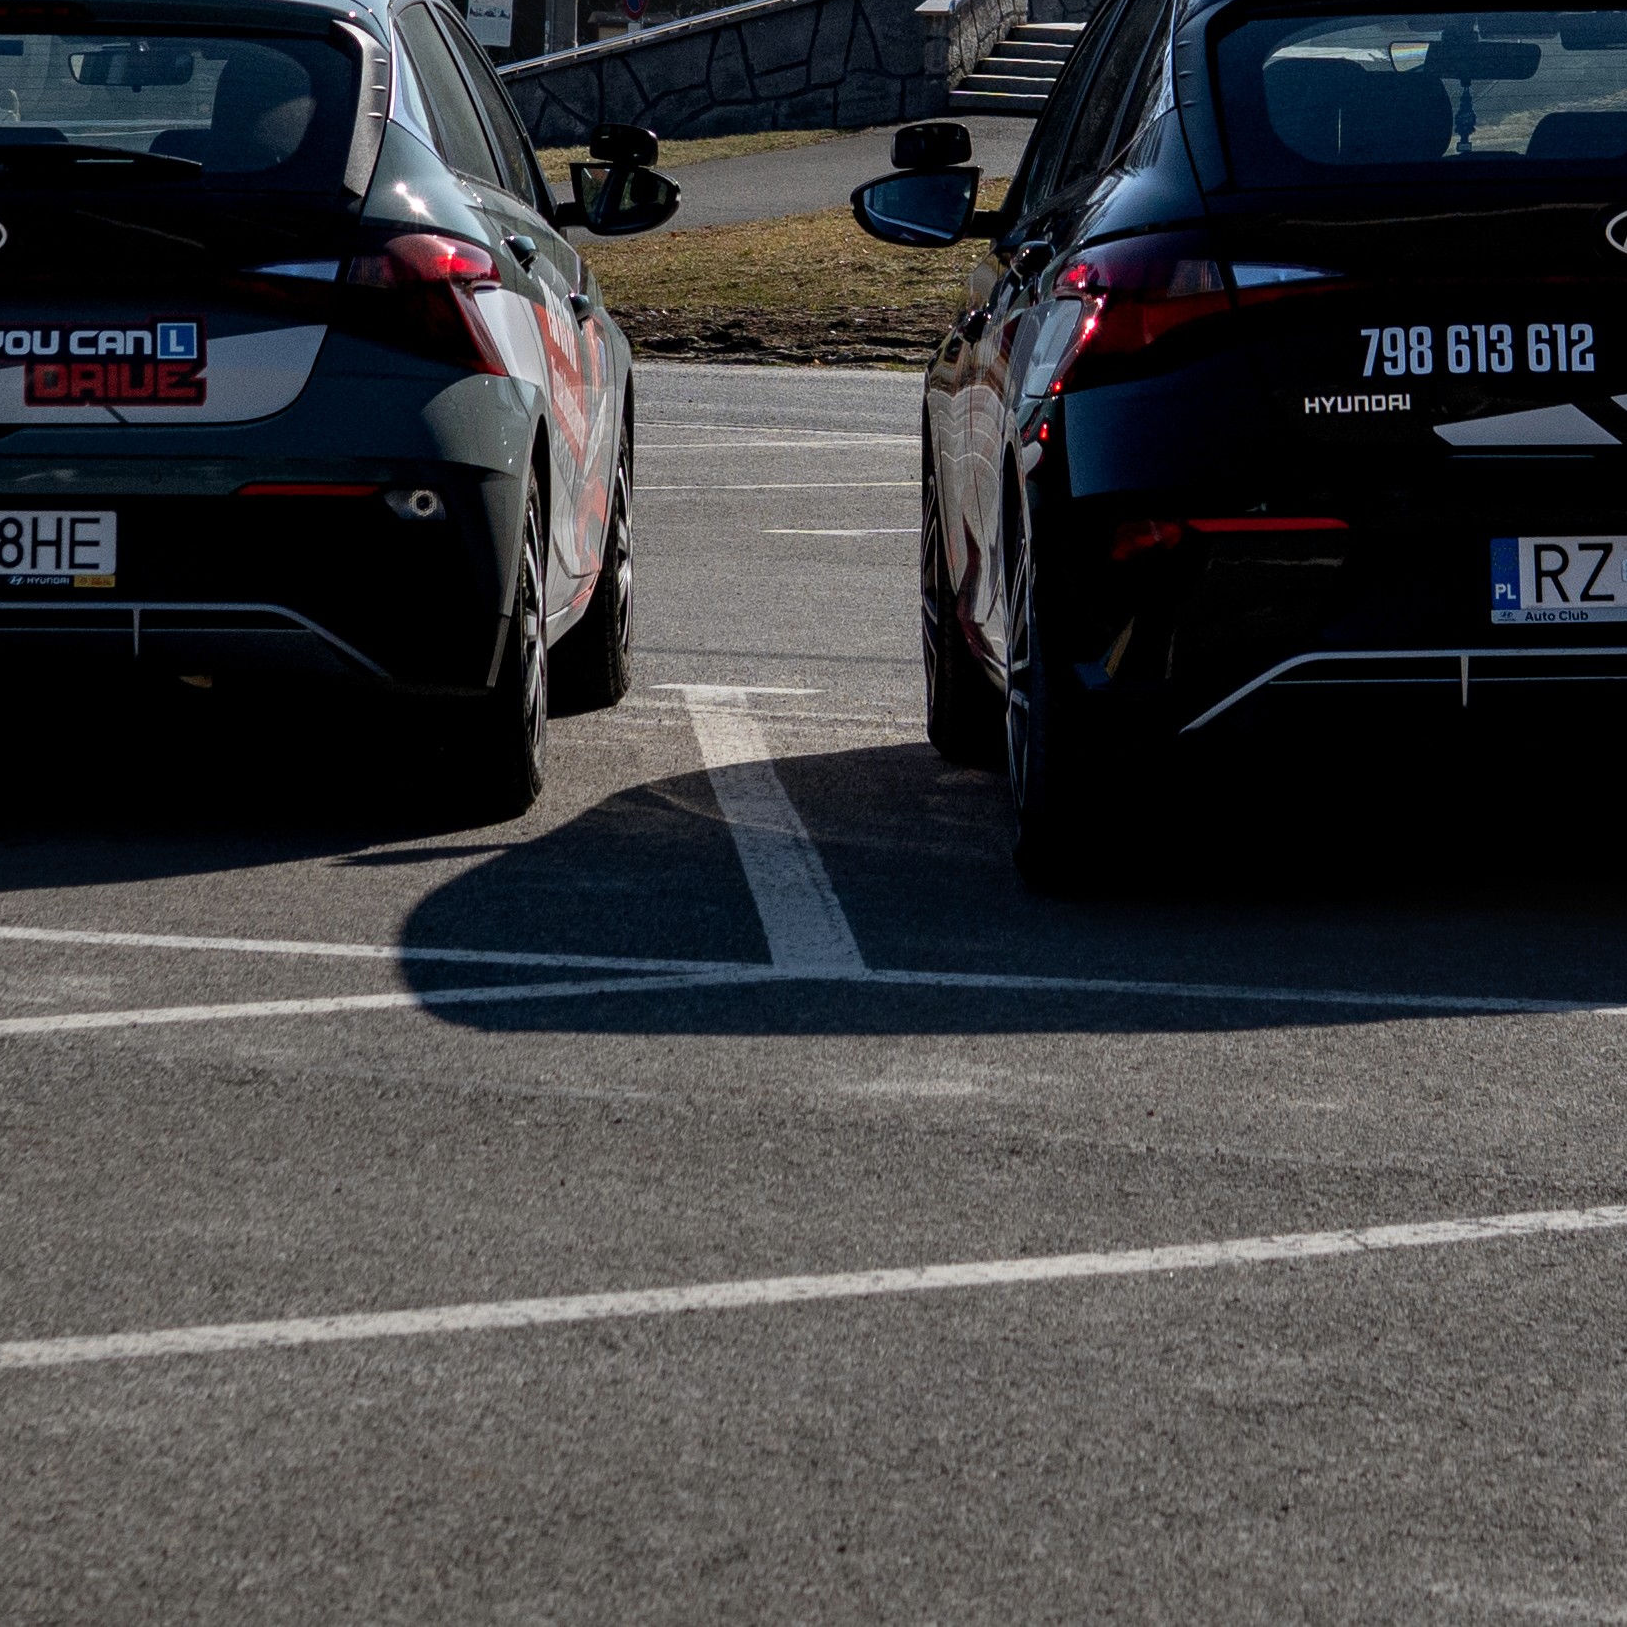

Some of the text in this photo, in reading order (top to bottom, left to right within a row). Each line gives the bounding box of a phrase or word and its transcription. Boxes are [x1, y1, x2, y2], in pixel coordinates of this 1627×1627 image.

[69, 330, 153, 355] CAN
[169, 329, 185, 352] L
[1360, 323, 1595, 378] 798 613 612
[32, 363, 199, 398] DRIVE
[1304, 393, 1411, 414] HYUNDAI
[26, 576, 70, 585] HYUNDAI
[1533, 543, 1615, 603] RZ
[1494, 583, 1517, 600] PL
[1524, 610, 1589, 622] Auto Club
